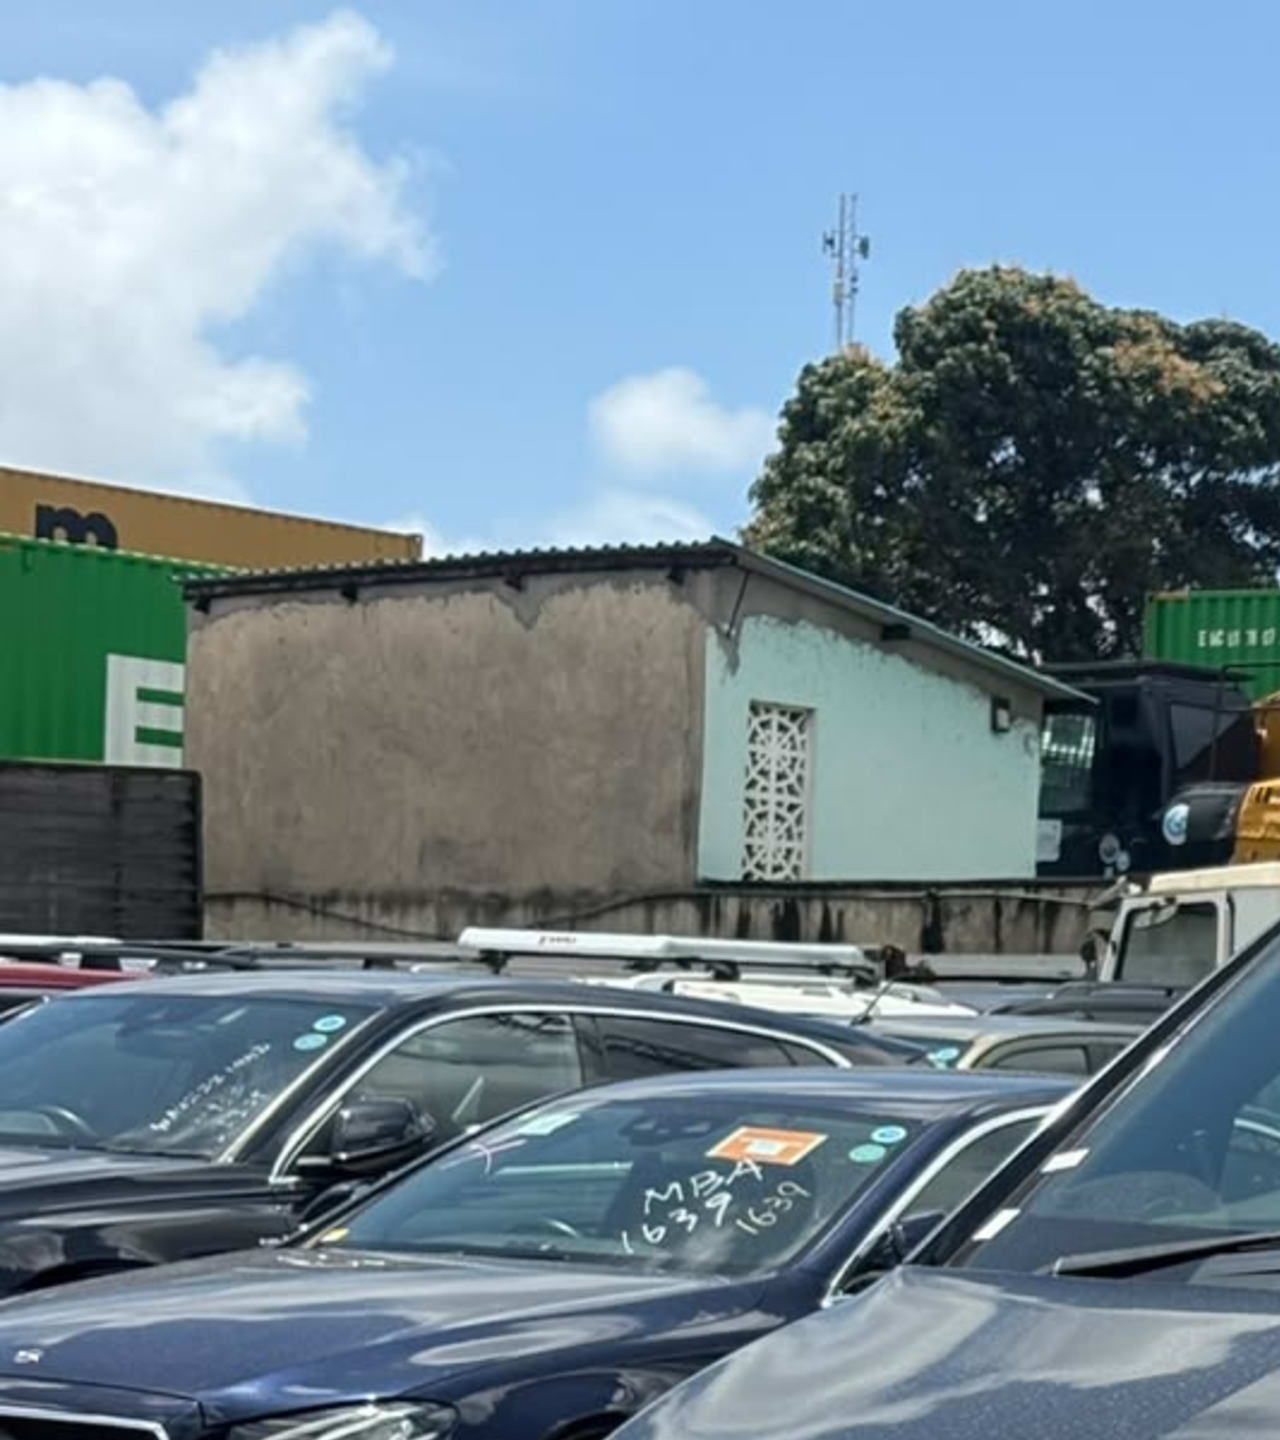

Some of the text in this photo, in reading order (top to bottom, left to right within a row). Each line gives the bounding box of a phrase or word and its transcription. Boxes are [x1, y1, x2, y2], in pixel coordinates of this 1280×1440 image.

[644, 1159, 763, 1214] MBA
[736, 1181, 812, 1235] 1639
[621, 1192, 732, 1255] 1639
